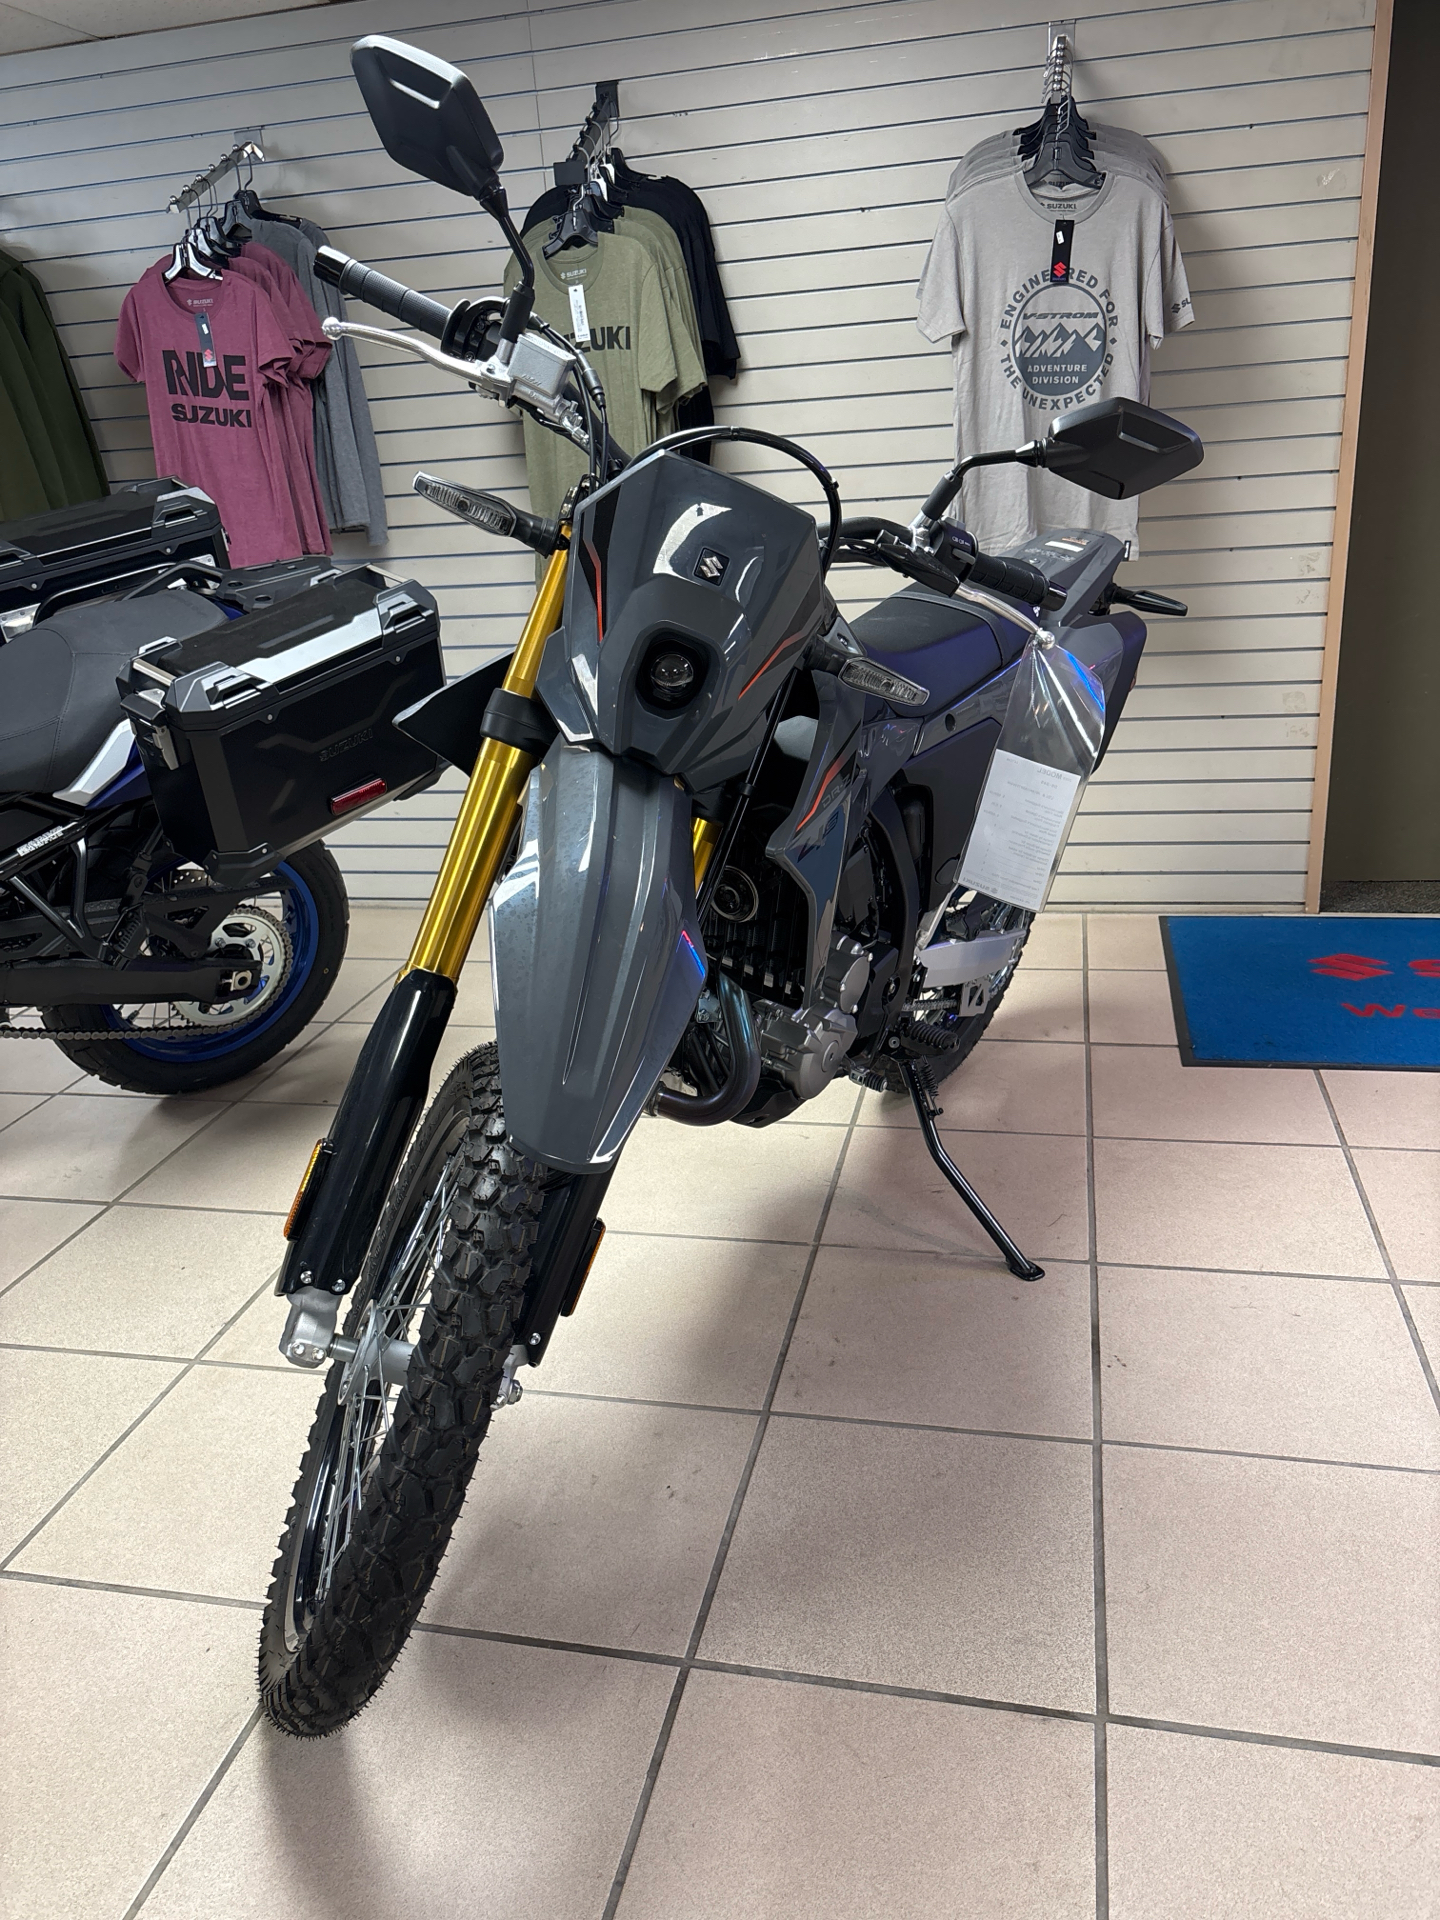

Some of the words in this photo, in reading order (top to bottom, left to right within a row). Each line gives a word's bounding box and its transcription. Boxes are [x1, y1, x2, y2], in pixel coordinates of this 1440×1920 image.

[1000, 267, 1098, 330] ENGINERED
[1099, 288, 1118, 328] FOR
[1023, 311, 1100, 320] V-STROM
[162, 349, 250, 401] RIDE
[1000, 354, 1022, 389] THE
[1022, 353, 1114, 411] UNEXPECTED
[1027, 364, 1088, 372] ADVENTURE
[1032, 376, 1079, 384] DIVISION
[171, 403, 252, 428] SUZUKI
[319, 728, 374, 762] SUZUKI
